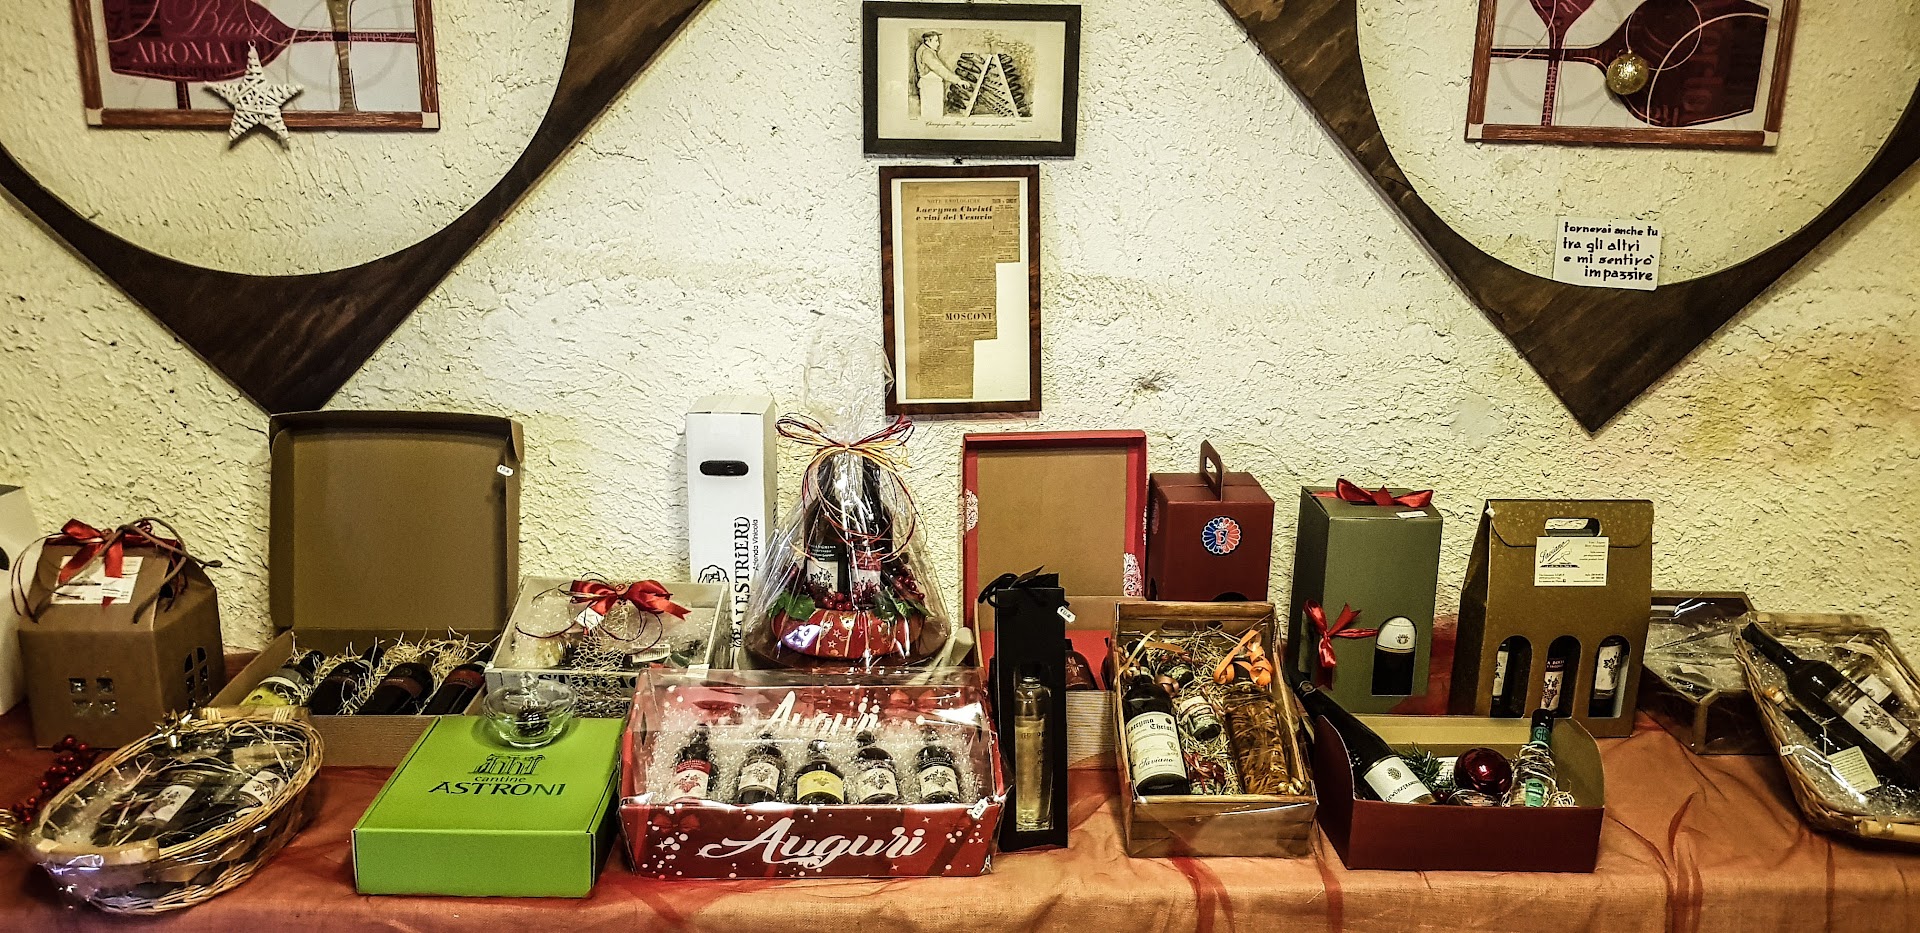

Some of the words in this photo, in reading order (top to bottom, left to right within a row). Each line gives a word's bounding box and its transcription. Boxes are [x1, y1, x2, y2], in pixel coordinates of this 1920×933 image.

[131, 41, 233, 64] AROMA
[915, 206, 958, 215] Lacryma
[960, 205, 993, 213] Christi
[1563, 221, 1612, 234] tornerai
[1614, 225, 1644, 236] anche
[1647, 225, 1659, 237] tu
[1563, 236, 1582, 250] tra
[1607, 238, 1640, 252] altri
[1563, 255, 1572, 263] e
[1577, 253, 1593, 264] mi
[1598, 253, 1655, 266] sentirò
[945, 312, 992, 321] MOSCONI
[752, 519, 760, 544] Vinicola
[1138, 756, 1173, 770] Saviano
[427, 781, 566, 796] ASTRONI
[696, 816, 928, 870] Auguri
